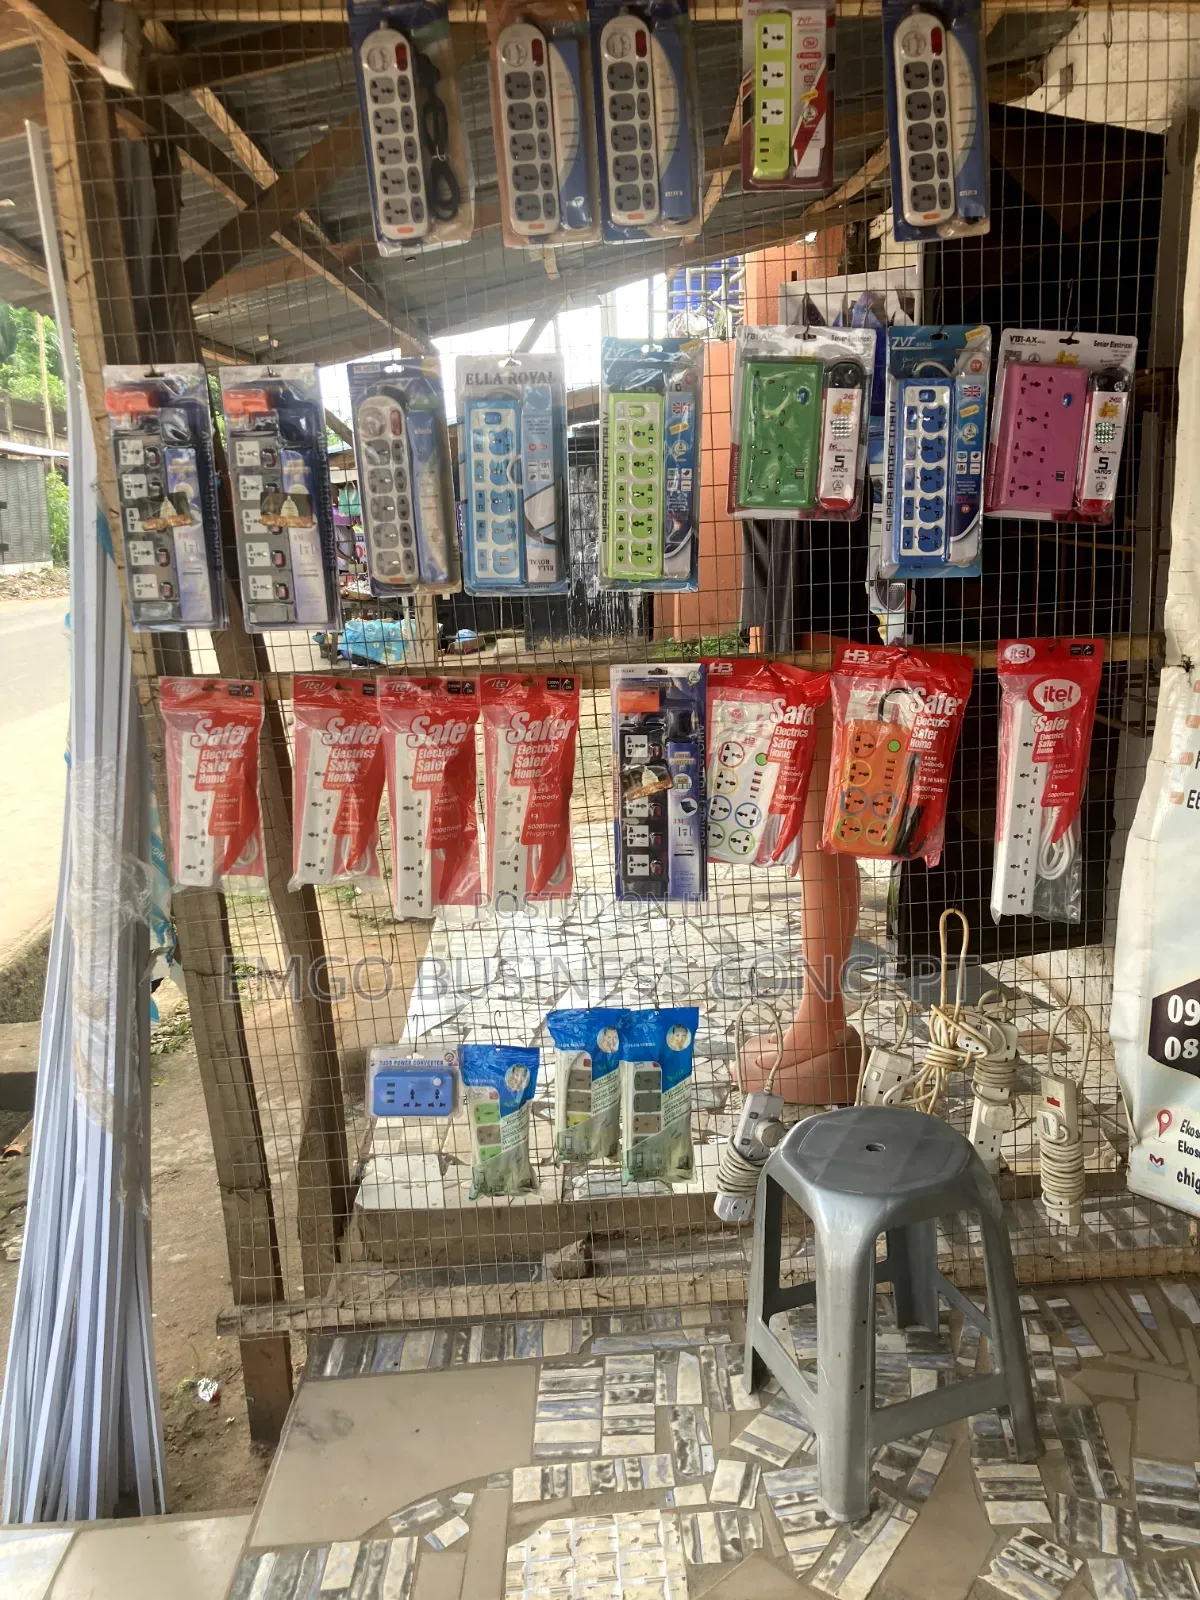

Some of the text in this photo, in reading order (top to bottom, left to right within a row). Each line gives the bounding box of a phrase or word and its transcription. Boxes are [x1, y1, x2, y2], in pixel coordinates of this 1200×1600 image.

[891, 336, 916, 348] ZVT
[1094, 340, 1132, 348] Senior Electrical
[466, 372, 504, 386] ELLA
[834, 455, 845, 468] 5
[1098, 456, 1109, 470] 5
[844, 650, 870, 661] HB
[1010, 648, 1030, 658] itel
[708, 662, 734, 672] HB
[1043, 686, 1074, 702] itel
[910, 687, 962, 716] Safer
[506, 711, 576, 744] Safer
[916, 716, 950, 728] Electrics
[1034, 716, 1070, 733] Safer
[190, 718, 254, 748] Safer
[774, 726, 808, 737] Electrics
[912, 726, 938, 740] Safer
[772, 736, 798, 750] Safer
[910, 738, 932, 749] Home
[202, 749, 244, 760] Electrics
[332, 748, 376, 758] Electrics
[517, 744, 560, 755] Electrics
[770, 748, 792, 759] Home
[200, 760, 232, 773] Safer
[328, 760, 360, 772] Safer
[416, 760, 448, 772] Safer
[514, 756, 547, 768] Safer
[198, 774, 226, 784] Home
[328, 772, 356, 782] Home
[416, 772, 443, 783] Home
[514, 768, 542, 779] Home
[1167, 994, 1200, 1026] 09
[1164, 1036, 1199, 1060] 08
[1176, 1167, 1200, 1195] chig
